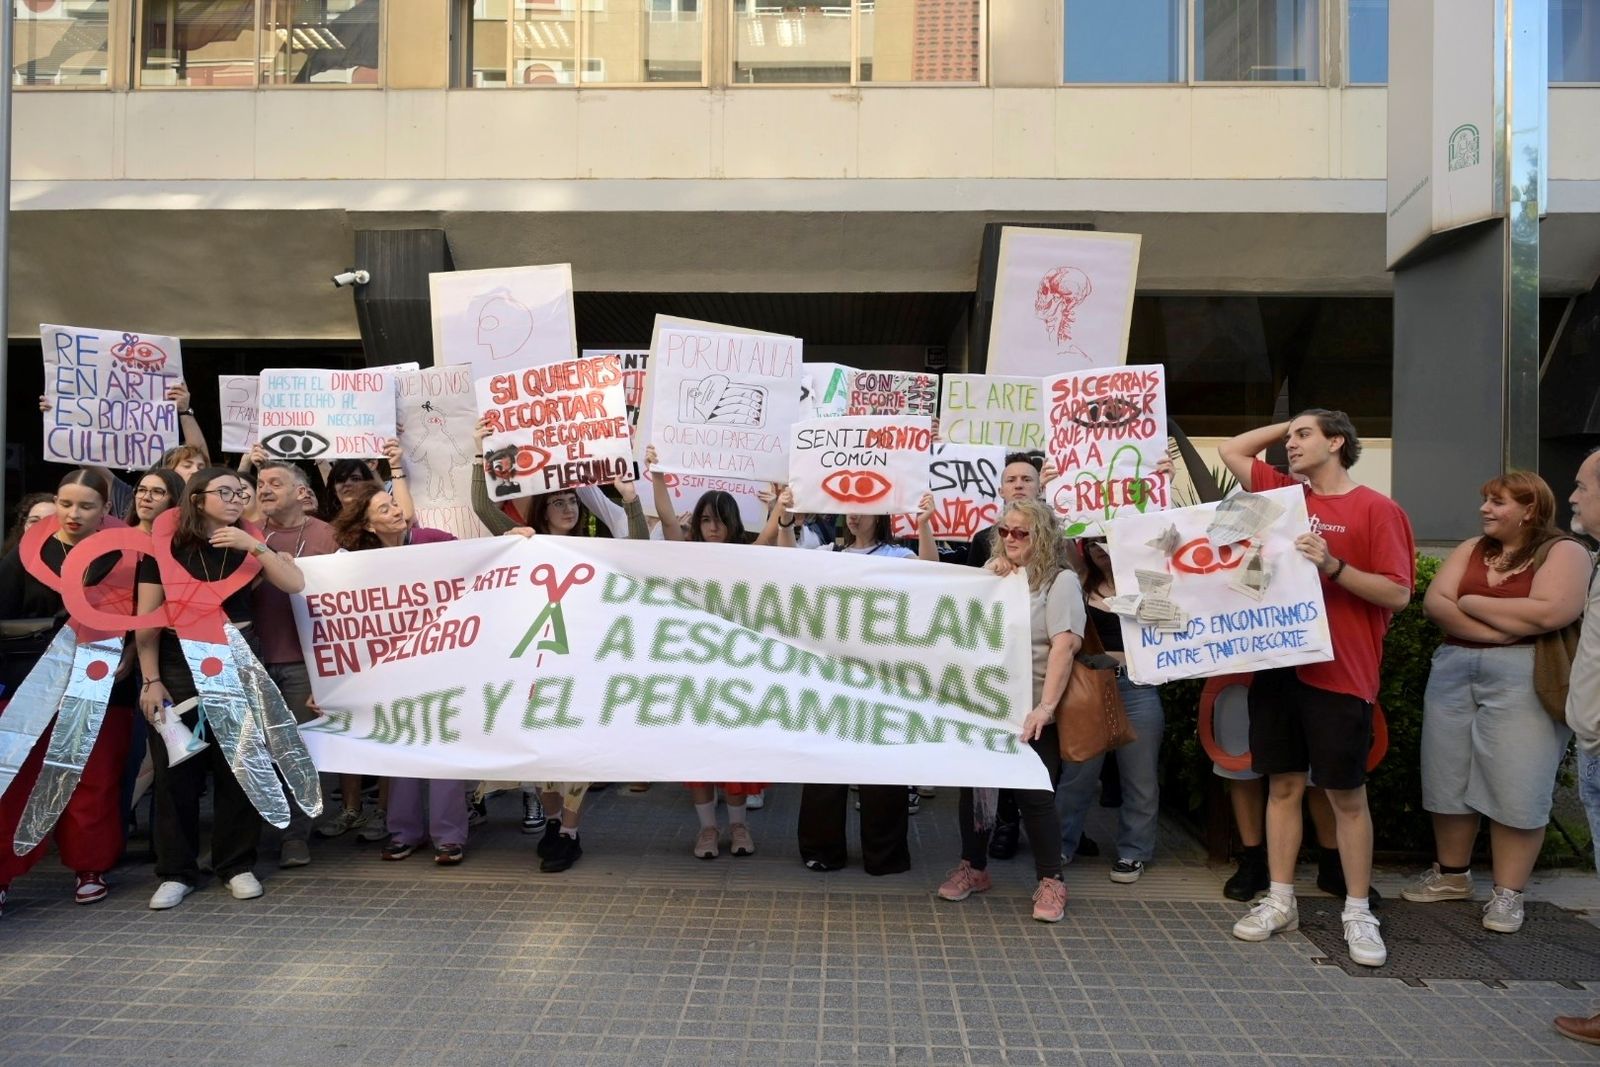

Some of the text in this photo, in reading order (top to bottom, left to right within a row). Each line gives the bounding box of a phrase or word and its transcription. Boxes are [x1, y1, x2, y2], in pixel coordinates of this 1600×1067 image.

[55, 332, 99, 367] RE
[56, 366, 98, 396] EN
[268, 372, 384, 392] HASTA EL DINERO
[420, 373, 442, 397] NO
[490, 374, 519, 404] SI
[522, 355, 621, 397] QUIERES
[855, 371, 894, 392] CON
[948, 380, 1038, 413] EL ARTE
[1051, 370, 1160, 403] SI CERRAIS
[55, 397, 175, 432] ES BORRAR
[261, 392, 286, 409] QUE
[288, 393, 301, 408] TE
[342, 392, 357, 409] AL
[485, 391, 608, 433] RECORTAR
[851, 390, 906, 408] RECORTE
[262, 410, 375, 427] BOLSILLO NECESITA
[48, 427, 165, 466] CULTURA
[335, 431, 386, 454] DISEÑO
[566, 441, 593, 460] EL
[820, 450, 888, 468] COMÚN
[1055, 441, 1103, 477] VA A
[682, 475, 704, 488] SIN
[928, 457, 997, 499] STAS
[306, 582, 429, 619] ESCUELAS
[434, 577, 466, 604] DE
[600, 571, 1006, 652] DESMANTELAN
[312, 604, 450, 644] ANDALUZAS
[594, 613, 636, 664] A
[313, 642, 361, 678] EN
[1156, 647, 1203, 670] ENTRE
[1251, 628, 1309, 654] RECORTE
[481, 680, 514, 736] Y
[521, 676, 583, 732] EL
